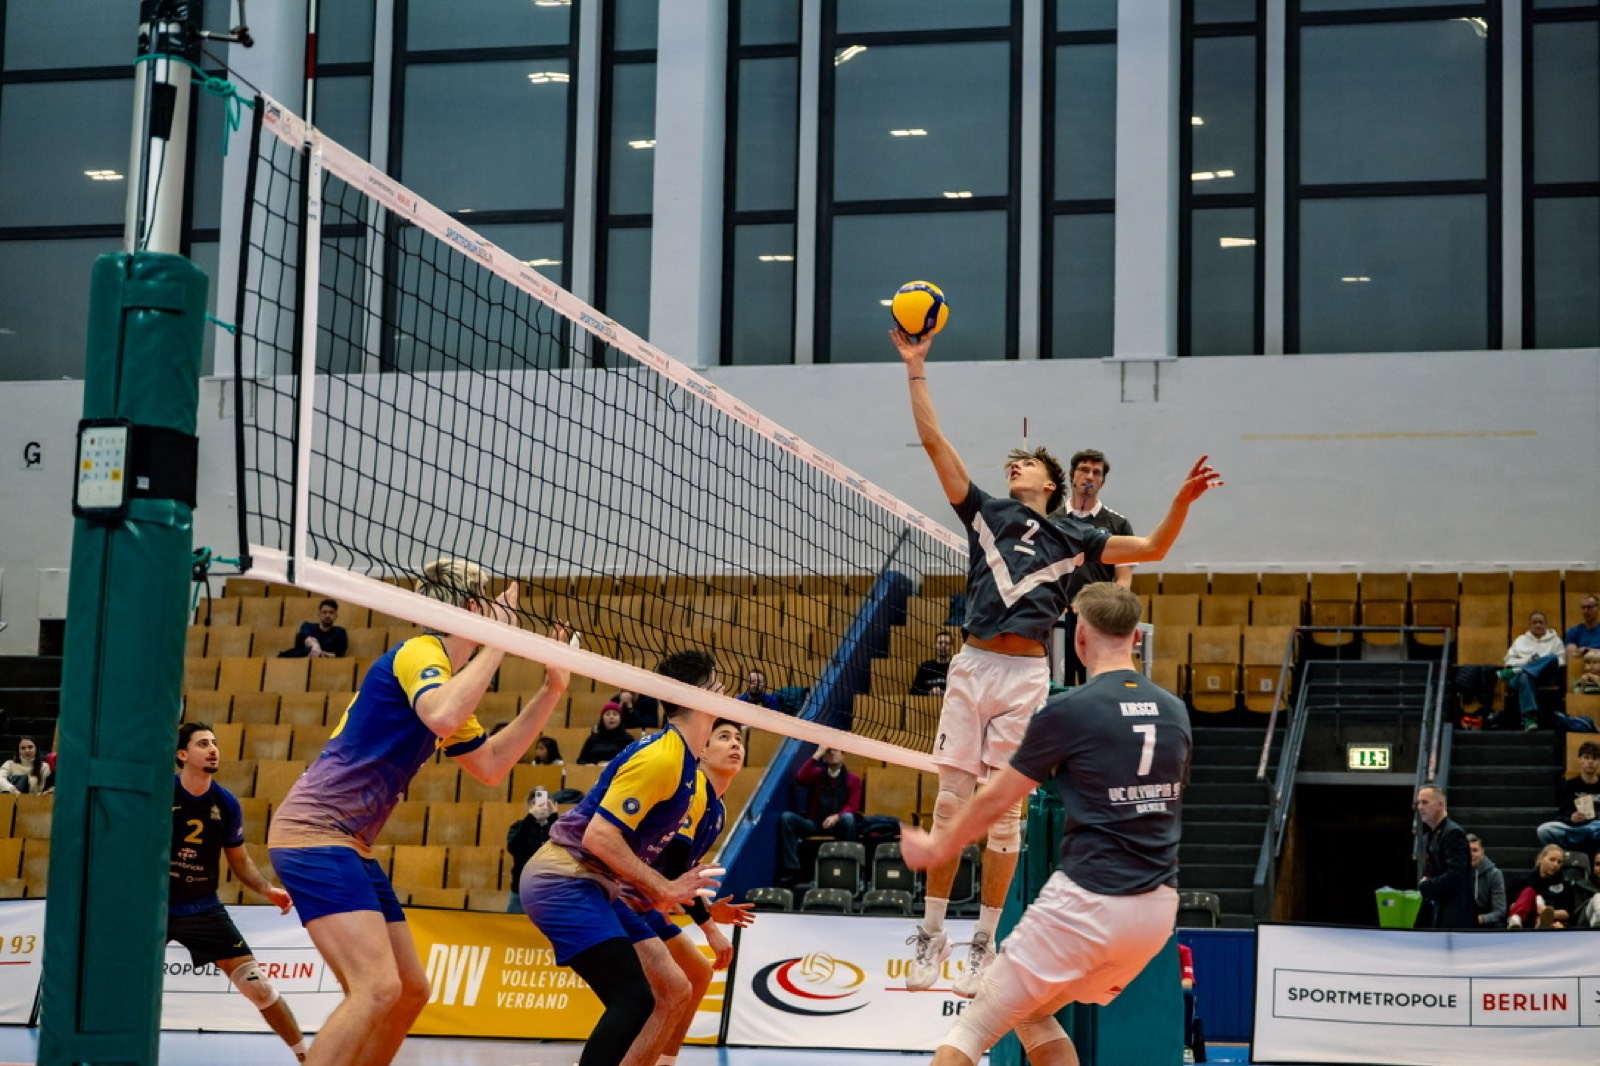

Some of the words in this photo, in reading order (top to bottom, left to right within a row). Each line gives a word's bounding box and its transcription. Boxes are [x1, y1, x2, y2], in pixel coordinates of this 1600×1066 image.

[24, 441, 41, 468] G
[1020, 519, 1040, 545] 2
[1132, 723, 1156, 776] 7
[183, 819, 204, 845] 2
[10, 934, 36, 954] 93
[504, 946, 557, 966] DEUTS
[501, 969, 591, 988] VOLLEYBAL
[497, 992, 568, 1010] VERBAND
[1288, 986, 1457, 1008] SPORTMETROPOLE
[1482, 992, 1567, 1012] BERLIN
